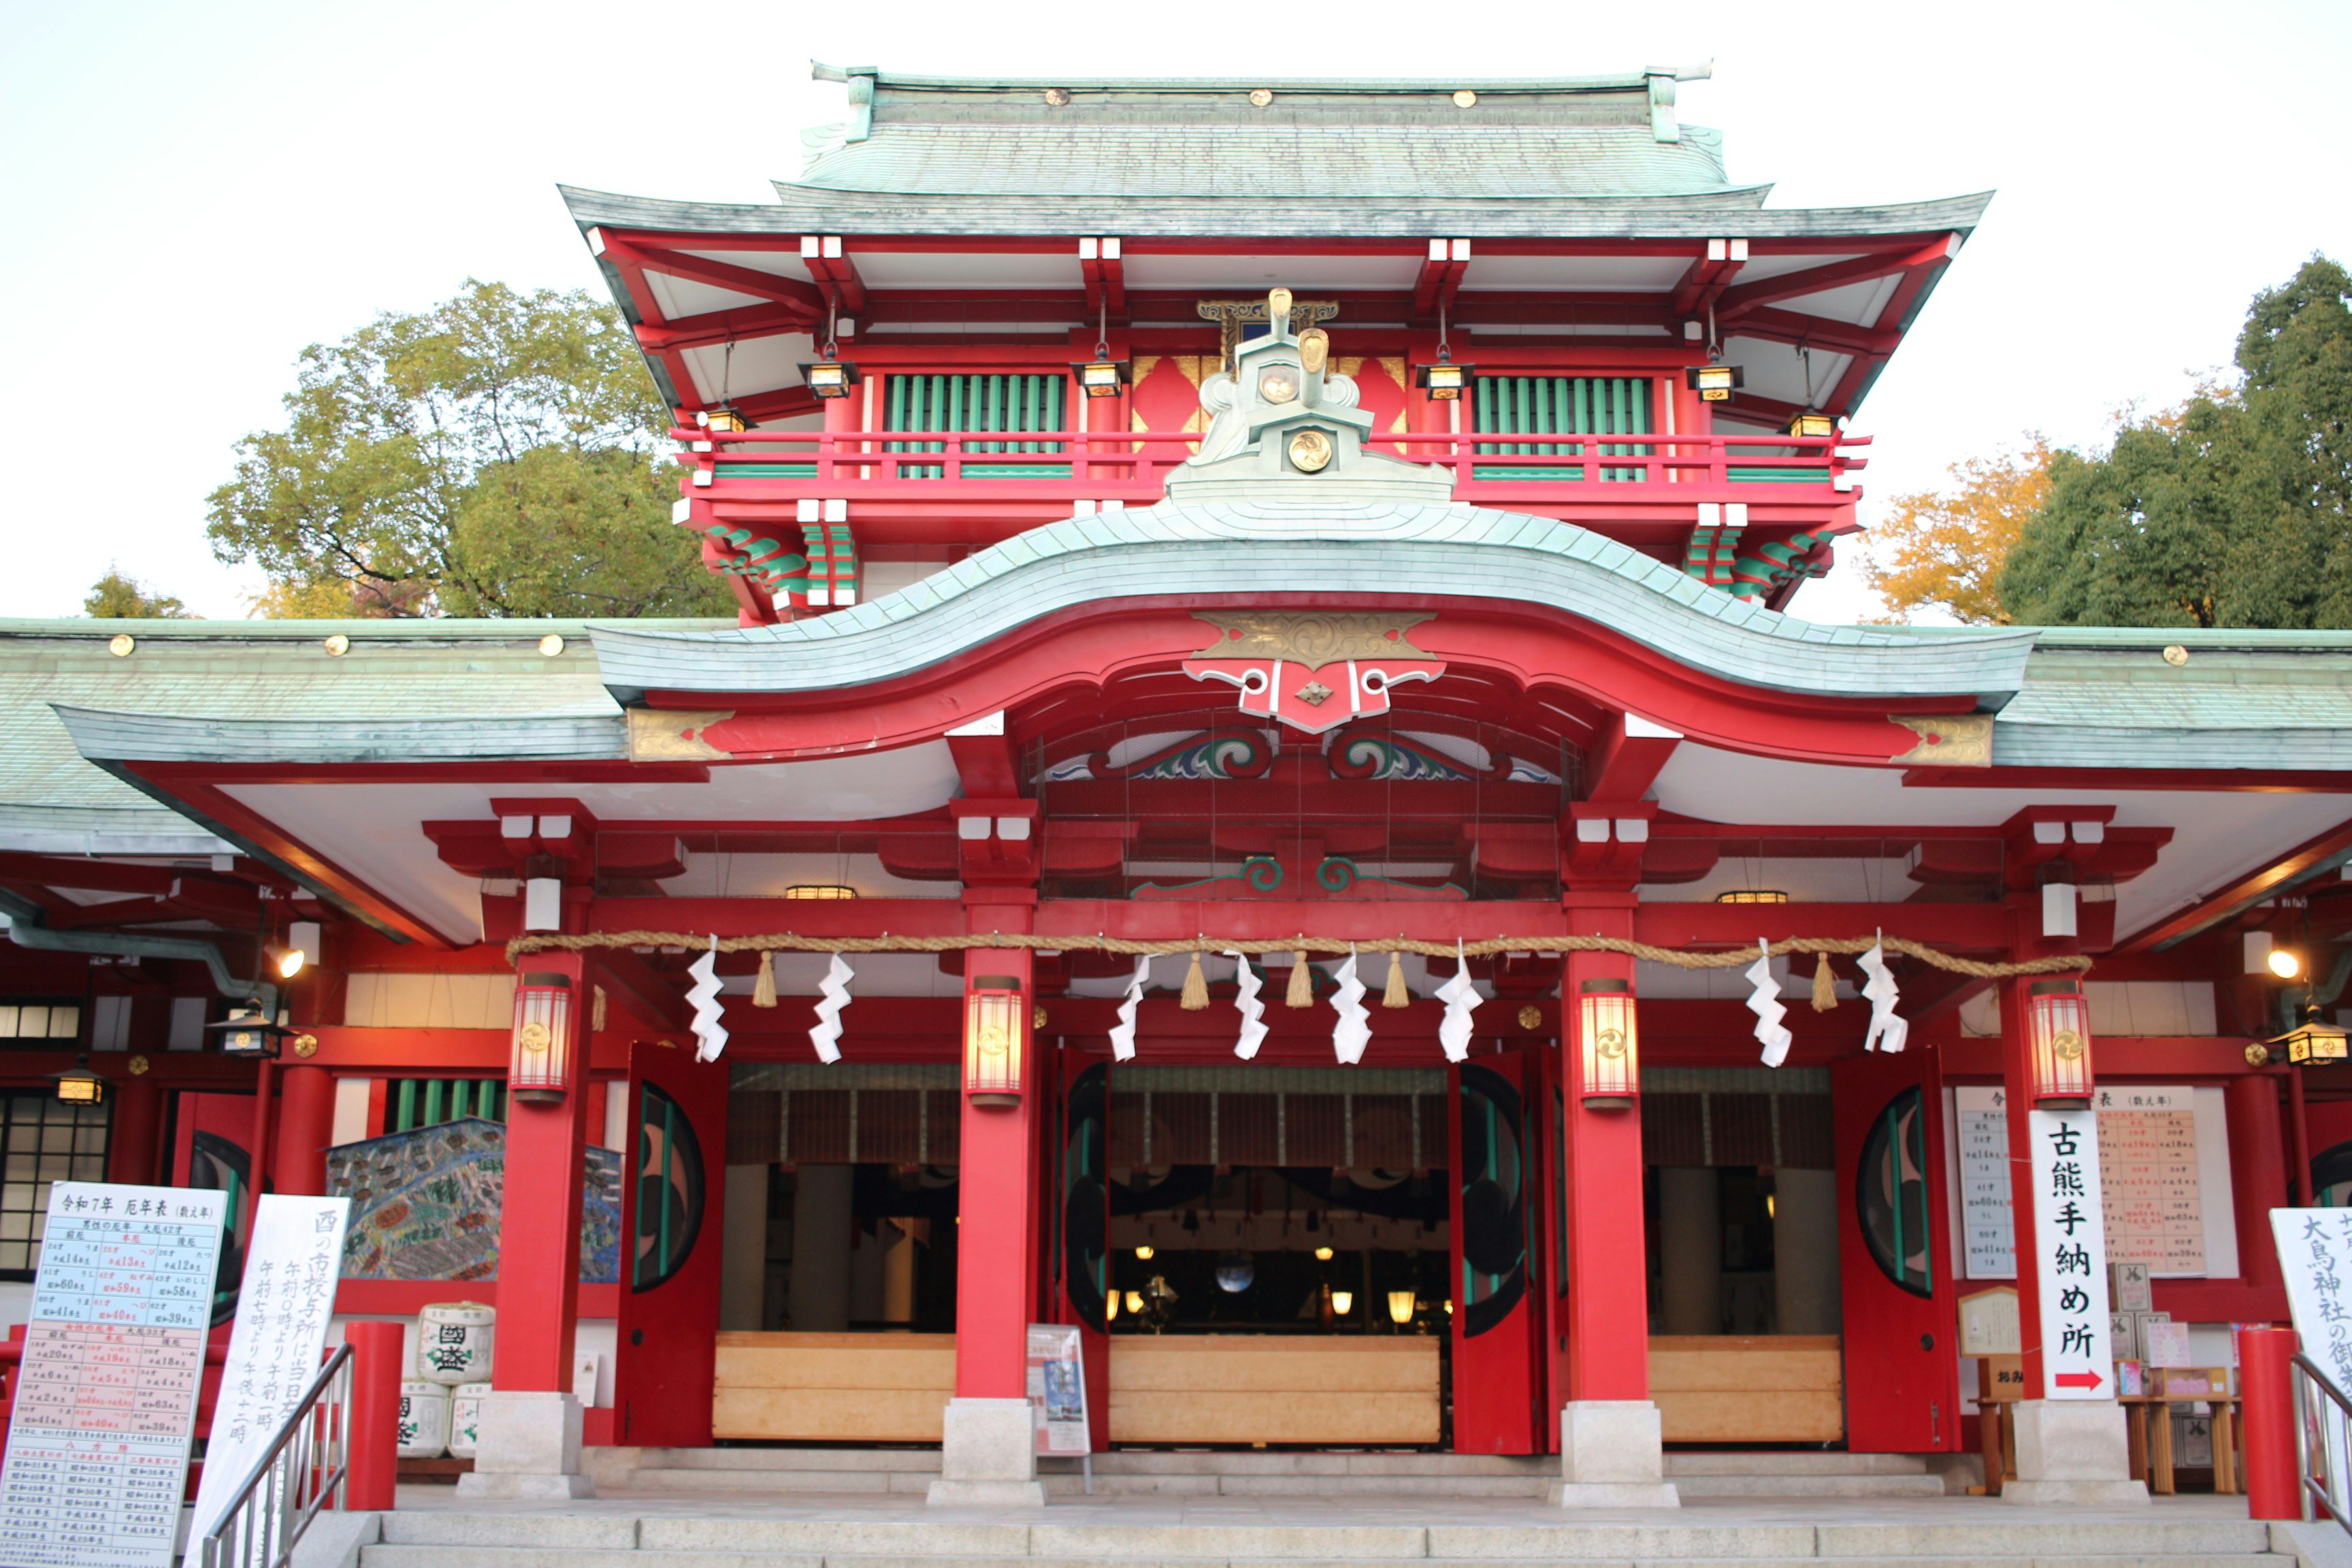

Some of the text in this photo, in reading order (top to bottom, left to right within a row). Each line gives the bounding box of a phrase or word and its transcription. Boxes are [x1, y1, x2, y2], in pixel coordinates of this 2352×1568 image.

[1992, 1091, 2005, 1107] 令
[61, 1194, 114, 1213] 令和7年
[124, 1198, 169, 1217] 厄年表
[65, 1230, 85, 1240] 前厄
[82, 1220, 184, 1235] 男性の厄年 大厄42才
[2048, 1122, 2095, 1359] 古熊手納め所
[2301, 1215, 2352, 1397] 大鳥神社の御朱
[1997, 1370, 2023, 1384] おみ
